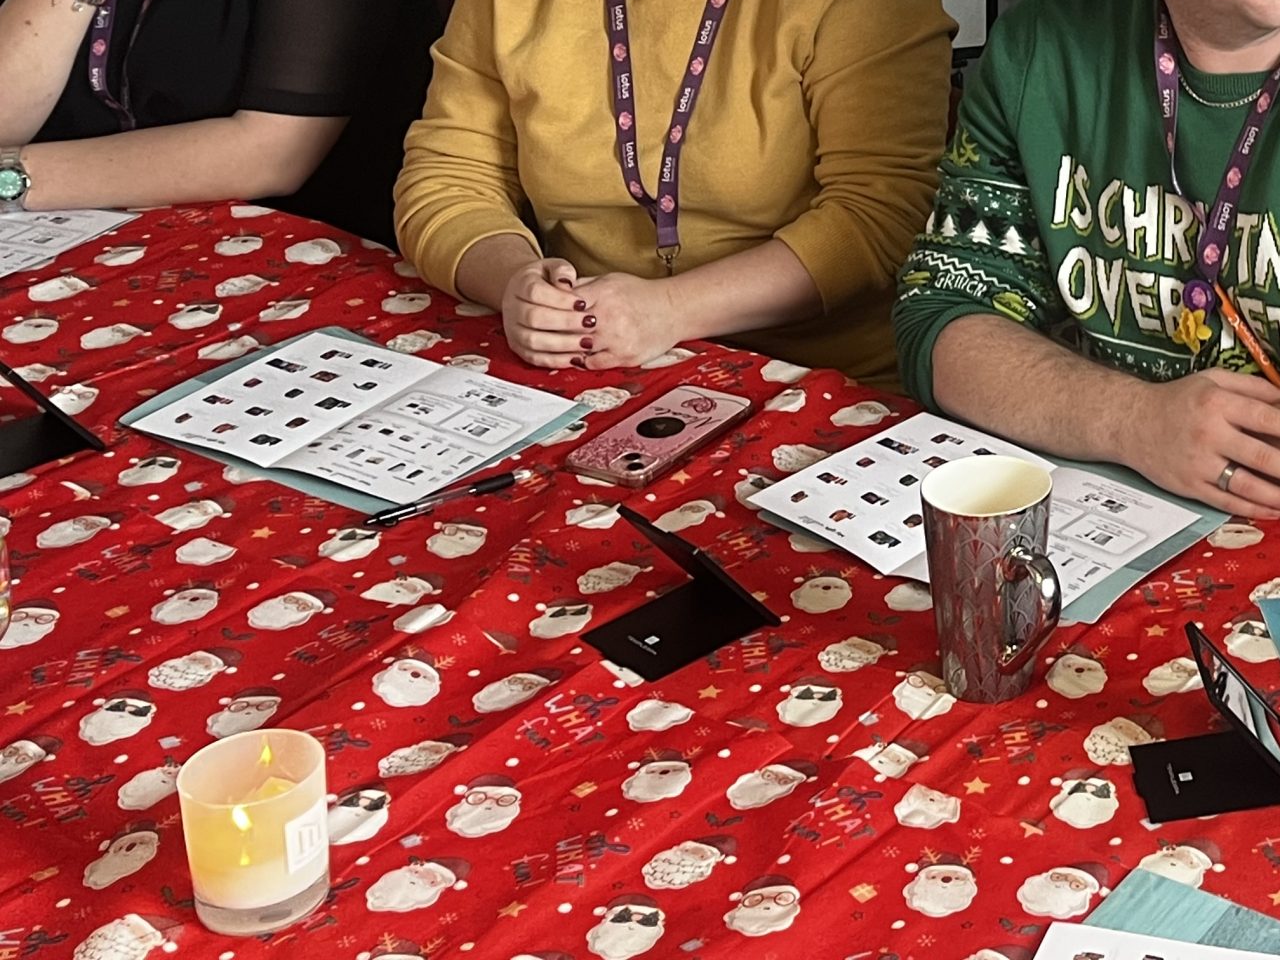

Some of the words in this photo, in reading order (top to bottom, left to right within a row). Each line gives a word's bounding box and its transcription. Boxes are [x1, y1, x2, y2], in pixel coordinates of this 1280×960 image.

[615, 5, 624, 30] lotus
[698, 20, 712, 45] lotus
[620, 73, 630, 99] lotus
[677, 88, 691, 113] lotus
[1242, 127, 1259, 155] lotus
[625, 142, 635, 168] lotus
[662, 156, 672, 182] lotus
[1051, 154, 1092, 236] IS
[1218, 202, 1233, 231] lotus
[935, 272, 988, 297] GRINCH
